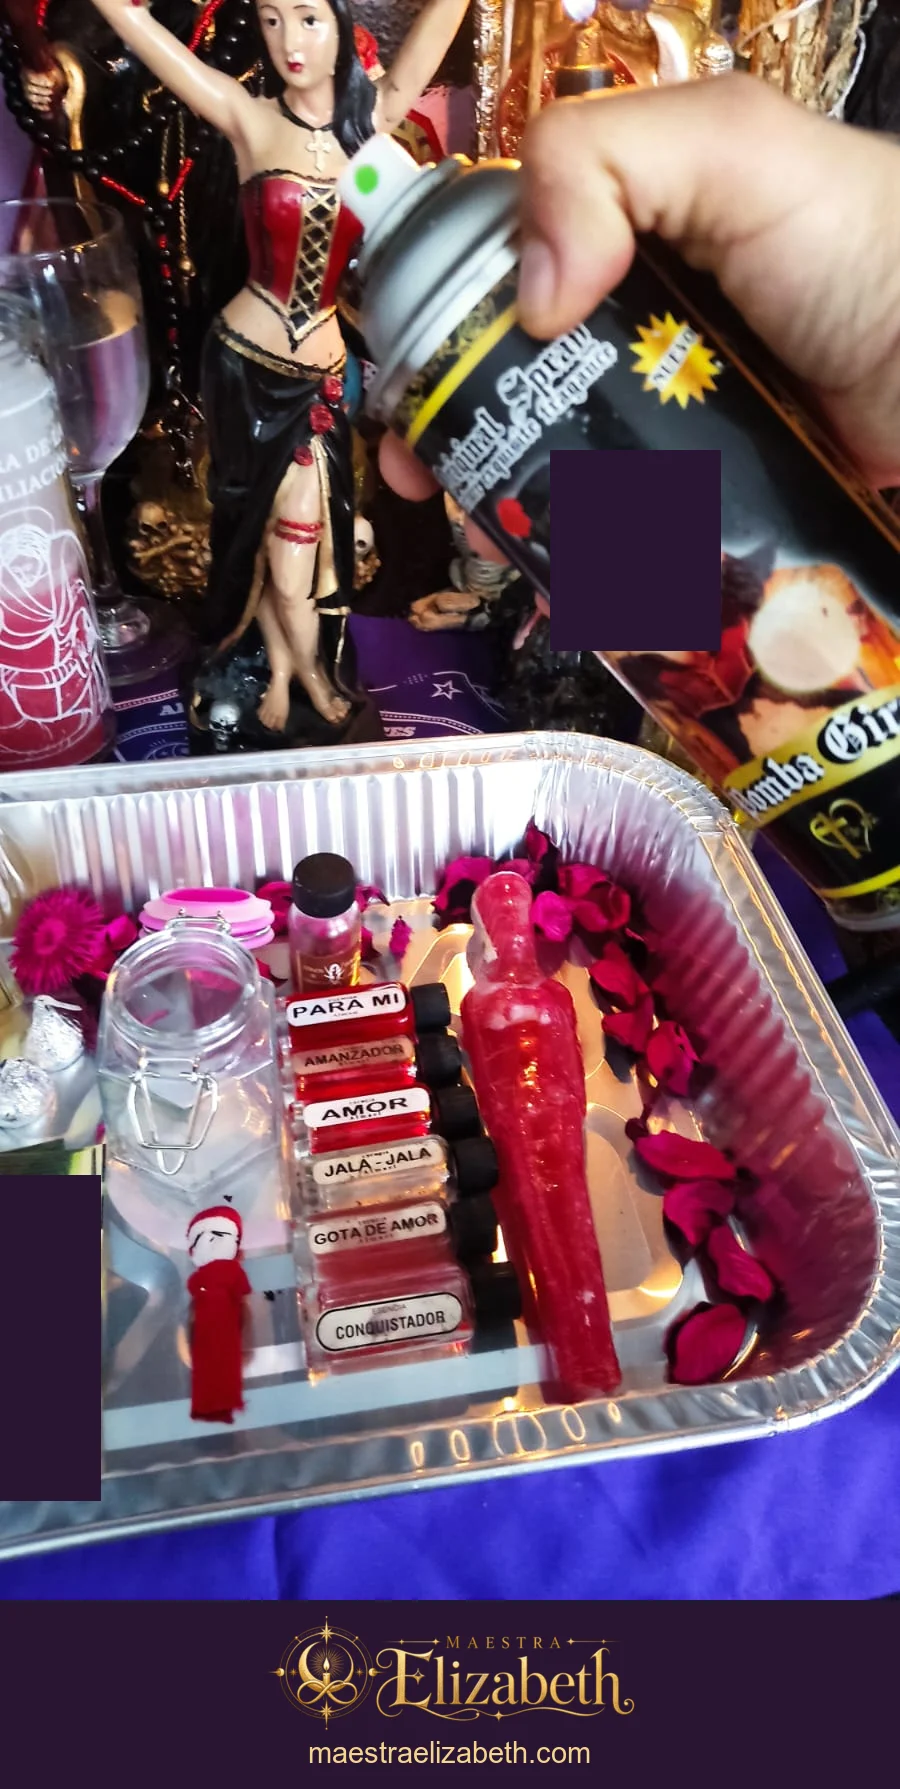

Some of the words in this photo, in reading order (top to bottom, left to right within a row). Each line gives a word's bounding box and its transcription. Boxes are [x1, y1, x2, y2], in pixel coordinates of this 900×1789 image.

[653, 327, 699, 386] NUEVO
[26, 436, 50, 464] DE
[820, 698, 900, 762] Gir
[293, 999, 364, 1018] PARA
[372, 993, 399, 1007] MI
[304, 1044, 404, 1067] AMANZADOR
[321, 1097, 409, 1121] AMOR
[325, 1159, 373, 1177] JALA
[386, 1147, 432, 1166] JALA
[314, 1227, 362, 1245] GOTA
[365, 1222, 387, 1237] DE
[391, 1213, 438, 1231] AMOR
[335, 1310, 446, 1339] CONQUISTADOR
